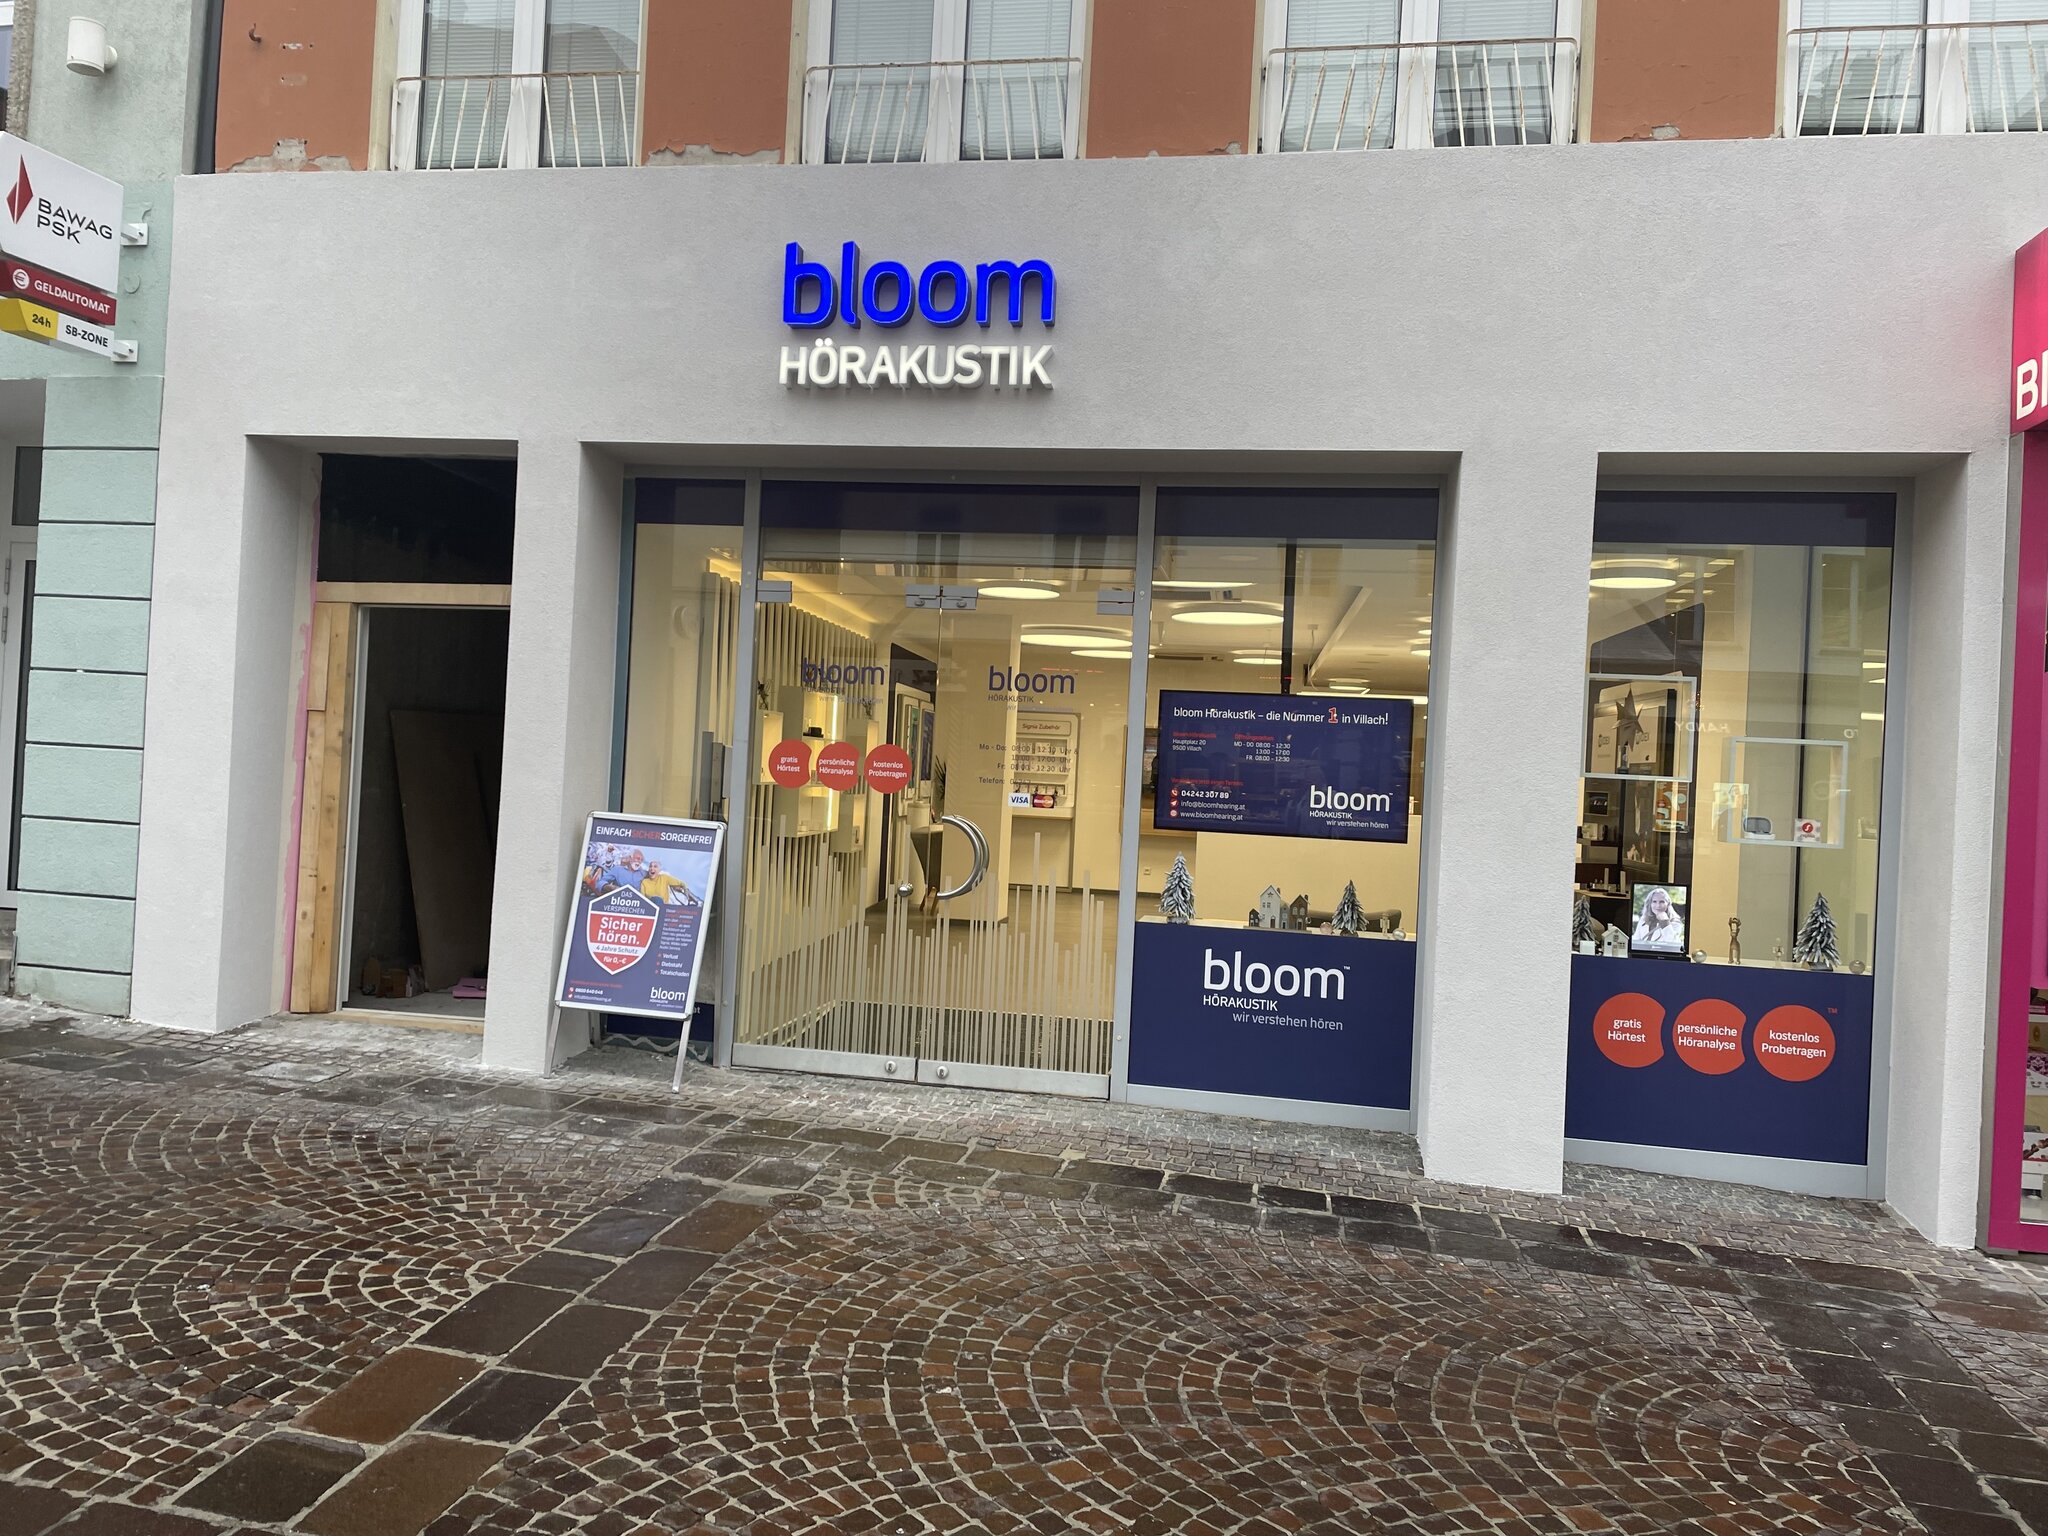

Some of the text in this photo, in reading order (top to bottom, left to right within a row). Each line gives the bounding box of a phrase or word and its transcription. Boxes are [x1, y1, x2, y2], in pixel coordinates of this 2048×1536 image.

[38, 197, 113, 240] BAWAG
[37, 214, 81, 244] PSK
[783, 240, 1057, 329] bloom
[34, 279, 111, 315] GELDAUTOMAT
[65, 324, 109, 348] SB-ZONE
[779, 337, 1054, 388] HÖRAKUSTIK
[803, 657, 884, 685] bloom
[988, 665, 1075, 694] bloom
[988, 694, 1034, 702] HÖRAKUSTIK
[1174, 707, 1203, 718] bloom
[1205, 708, 1256, 720] Hörakustik
[1266, 710, 1280, 721] die
[1283, 712, 1325, 723] Nummer
[1328, 707, 1338, 724] 1
[1342, 713, 1350, 723] in
[1353, 713, 1389, 725] Villach!
[780, 756, 798, 764] gratis
[818, 758, 855, 767] persönliche
[873, 760, 903, 769] kostenlos
[776, 764, 800, 772] Hörtest
[819, 767, 854, 776] Höranalyse
[868, 769, 907, 779] Probetragen
[1011, 796, 1028, 804] VISA
[1310, 785, 1390, 812] bloom
[1180, 801, 1245, 811] info@bloomhearing.at
[1180, 812, 1243, 821] www.bloomhearing.at
[1309, 810, 1352, 819] HÖRAKUSTIK
[1337, 820, 1369, 828] verstehen
[1370, 821, 1389, 829] hören
[610, 896, 640, 907] bloom
[603, 905, 645, 914] VERSPRECHEN
[600, 916, 643, 932] Sicher
[597, 929, 640, 945] hören.
[601, 945, 617, 953] Jahre
[1204, 948, 1345, 1000] bloom
[650, 986, 686, 1001] bloom
[1203, 993, 1278, 1012] HÖRAKUSTIK
[1232, 1011, 1343, 1031] wir verstehen hören
[1613, 1018, 1642, 1030] gratis
[1607, 1030, 1646, 1043] Hörtest
[1677, 1023, 1737, 1037] persönliche
[1769, 1029, 1820, 1043] kostenlos
[1678, 1037, 1736, 1051] Höranalyse
[1761, 1043, 1827, 1059] Probetragen
